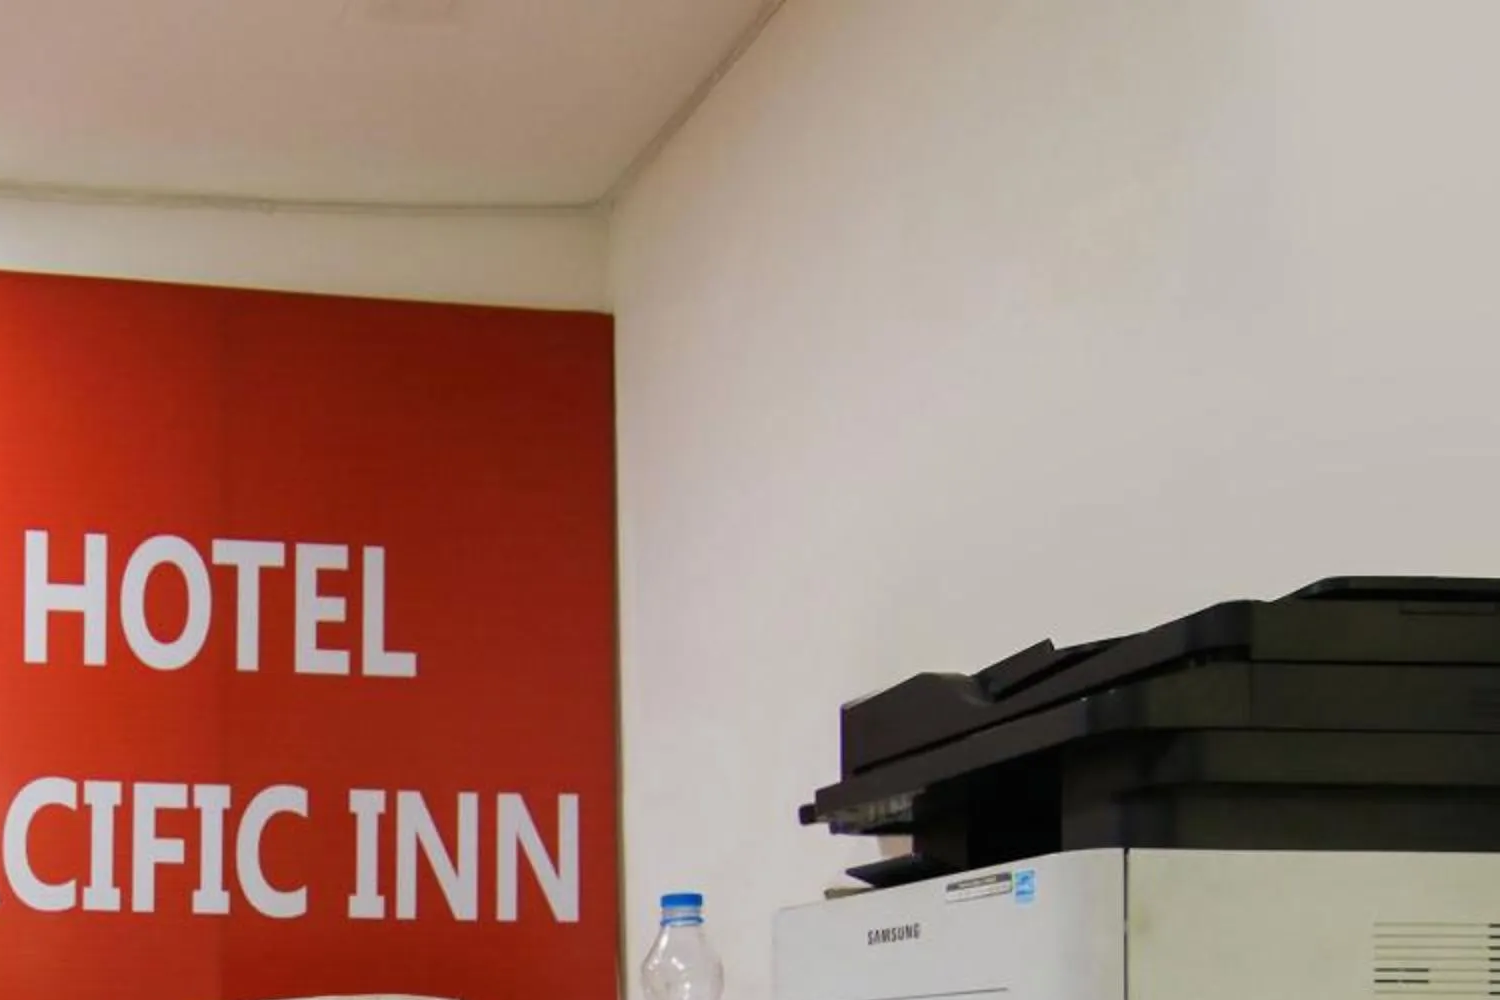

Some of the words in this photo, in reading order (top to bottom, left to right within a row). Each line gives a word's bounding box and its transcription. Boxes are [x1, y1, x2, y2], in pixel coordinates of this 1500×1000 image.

[22, 528, 418, 678] HOTEL
[347, 788, 580, 923] INN
[867, 922, 921, 946] SAMSUNG
